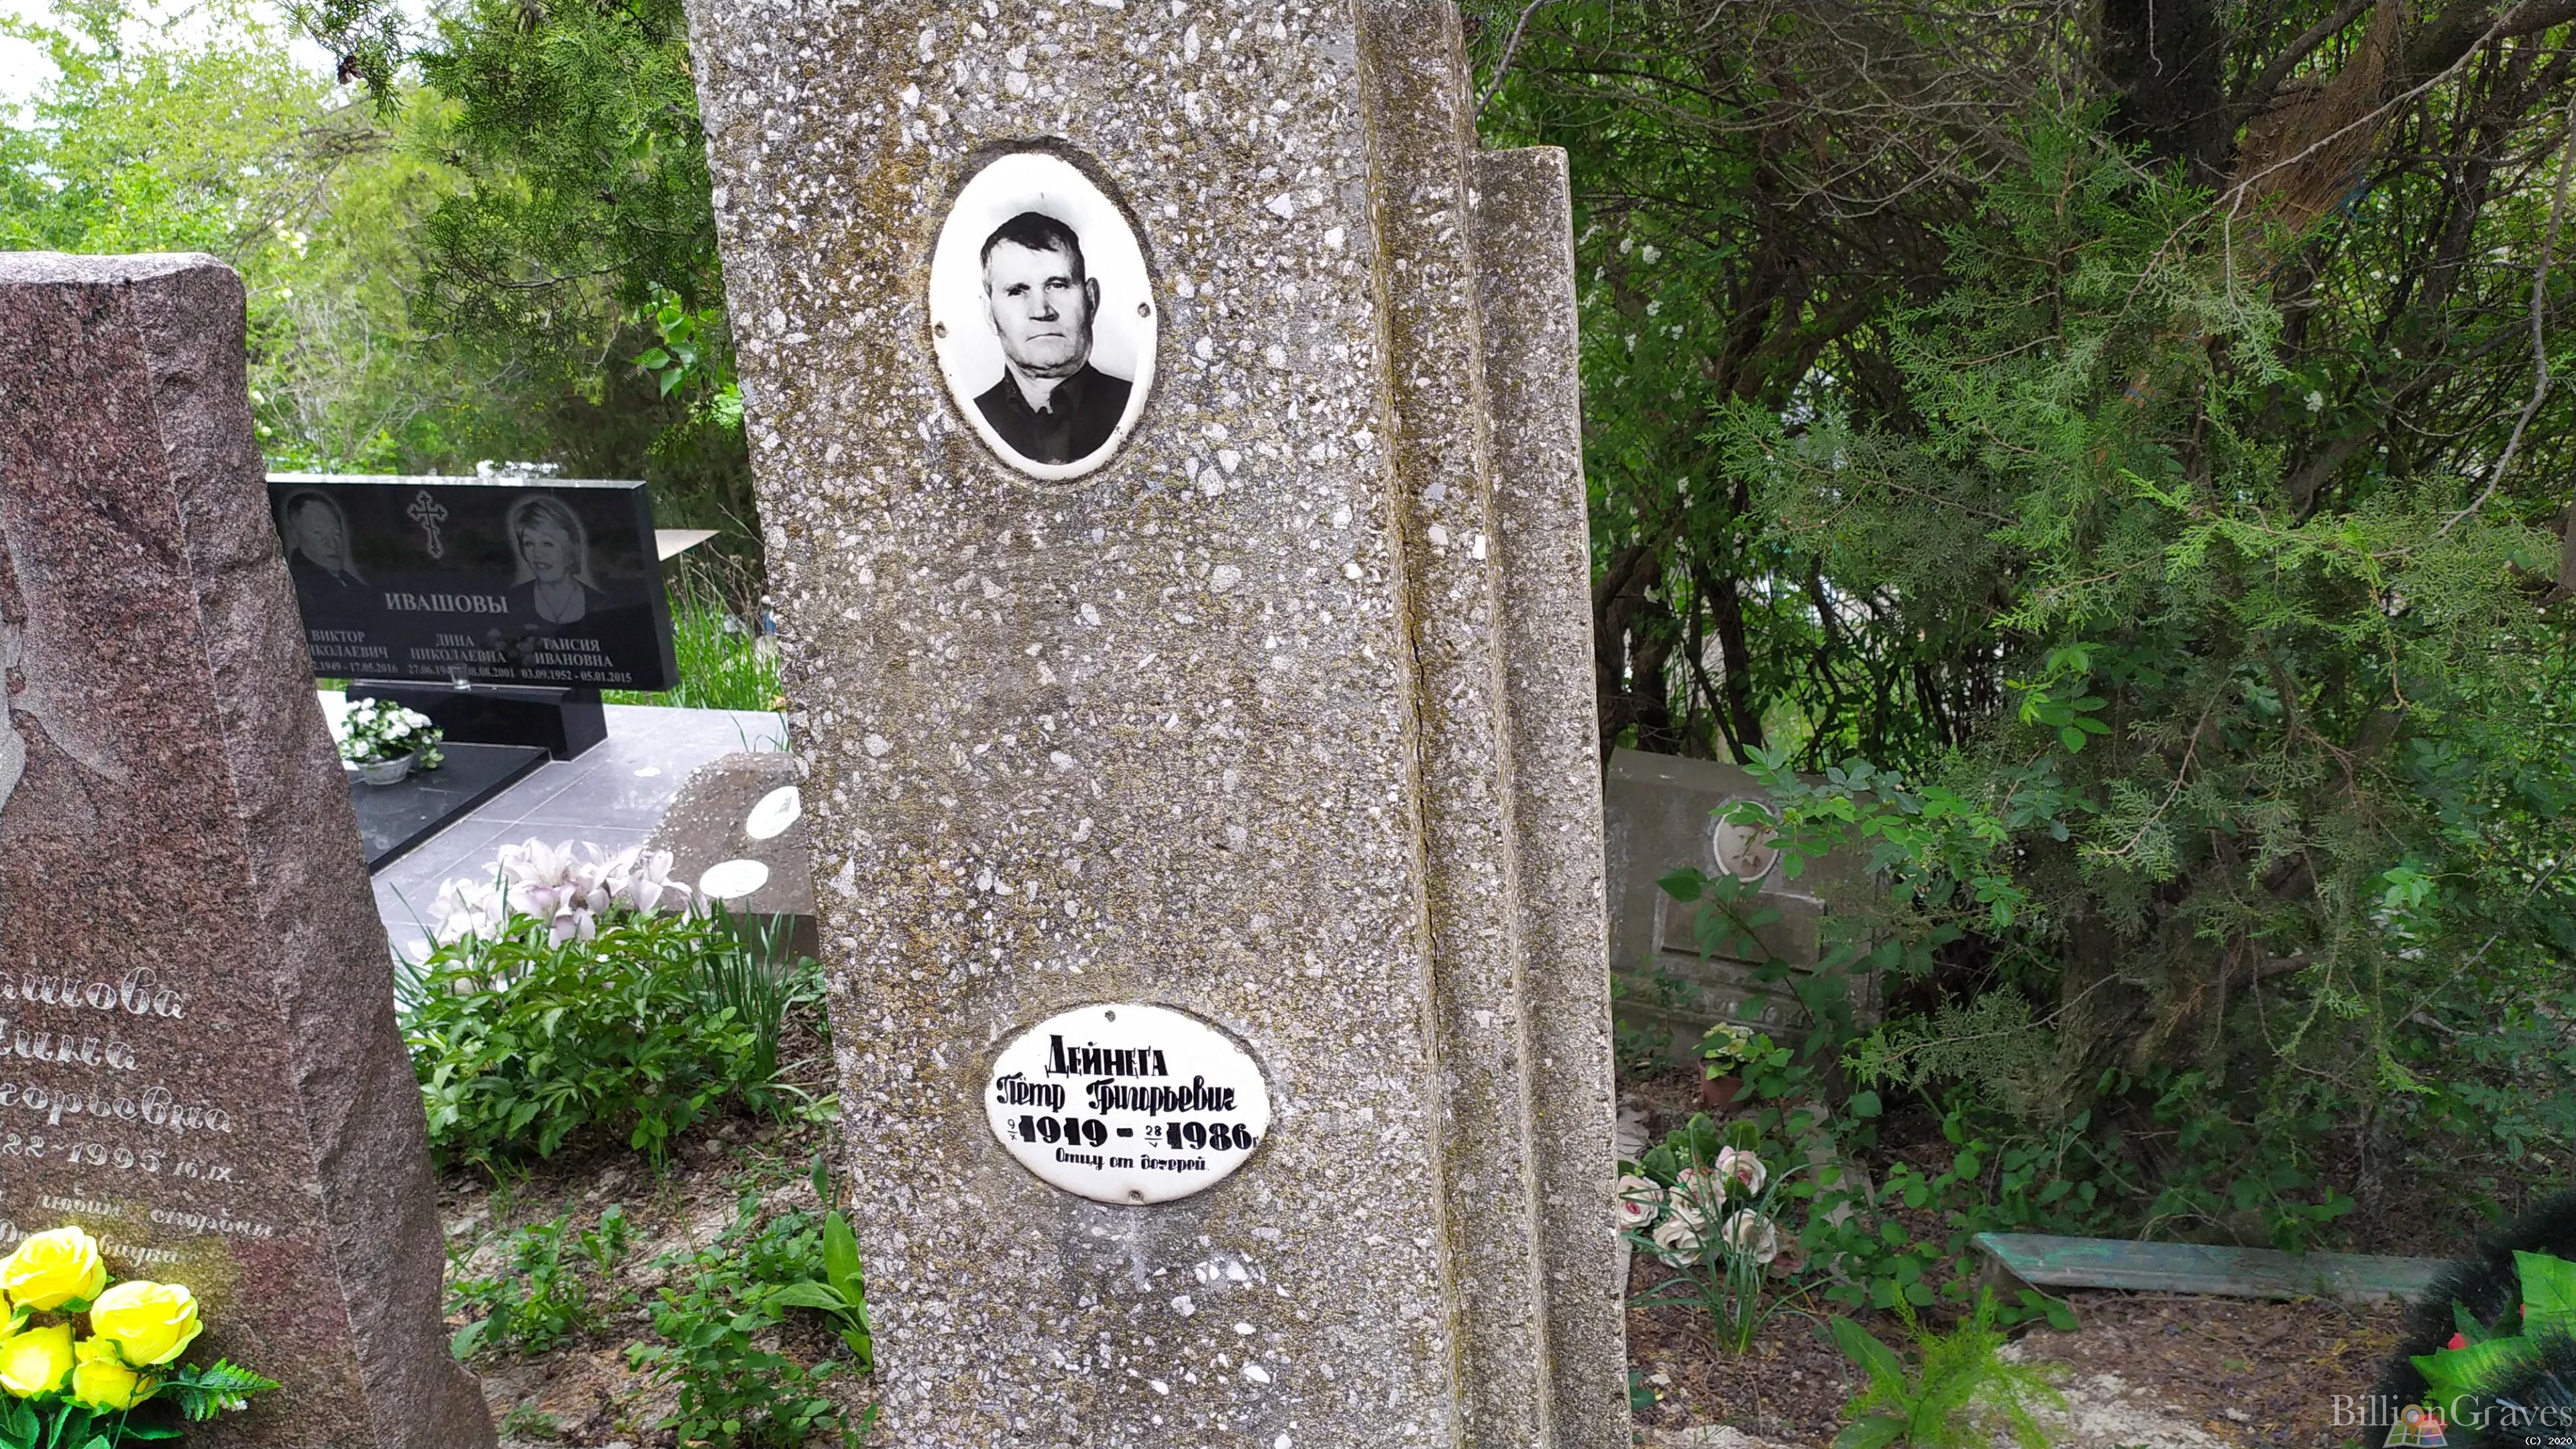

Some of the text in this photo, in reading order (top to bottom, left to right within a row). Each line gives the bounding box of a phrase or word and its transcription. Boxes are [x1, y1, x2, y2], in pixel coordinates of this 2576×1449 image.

[384, 592, 510, 614] ИВАШОВЫ
[311, 629, 365, 643] ВИКТОР
[436, 633, 475, 647] ДИНА
[542, 637, 601, 652] ТАИСИЯ
[410, 648, 507, 663] НИКОЛАЕВНА
[535, 651, 614, 667] ИВАНОВНА
[521, 668, 572, 681] 03.09.1952
[581, 672, 633, 684] 05.01.2015
[996, 1072, 1238, 1117] Пётр Григорьевич
[1018, 1115, 1108, 1148] 1919
[68, 1141, 167, 1173] 1995
[1056, 1147, 1105, 1170] Отцу
[1110, 1157, 1134, 1168] от
